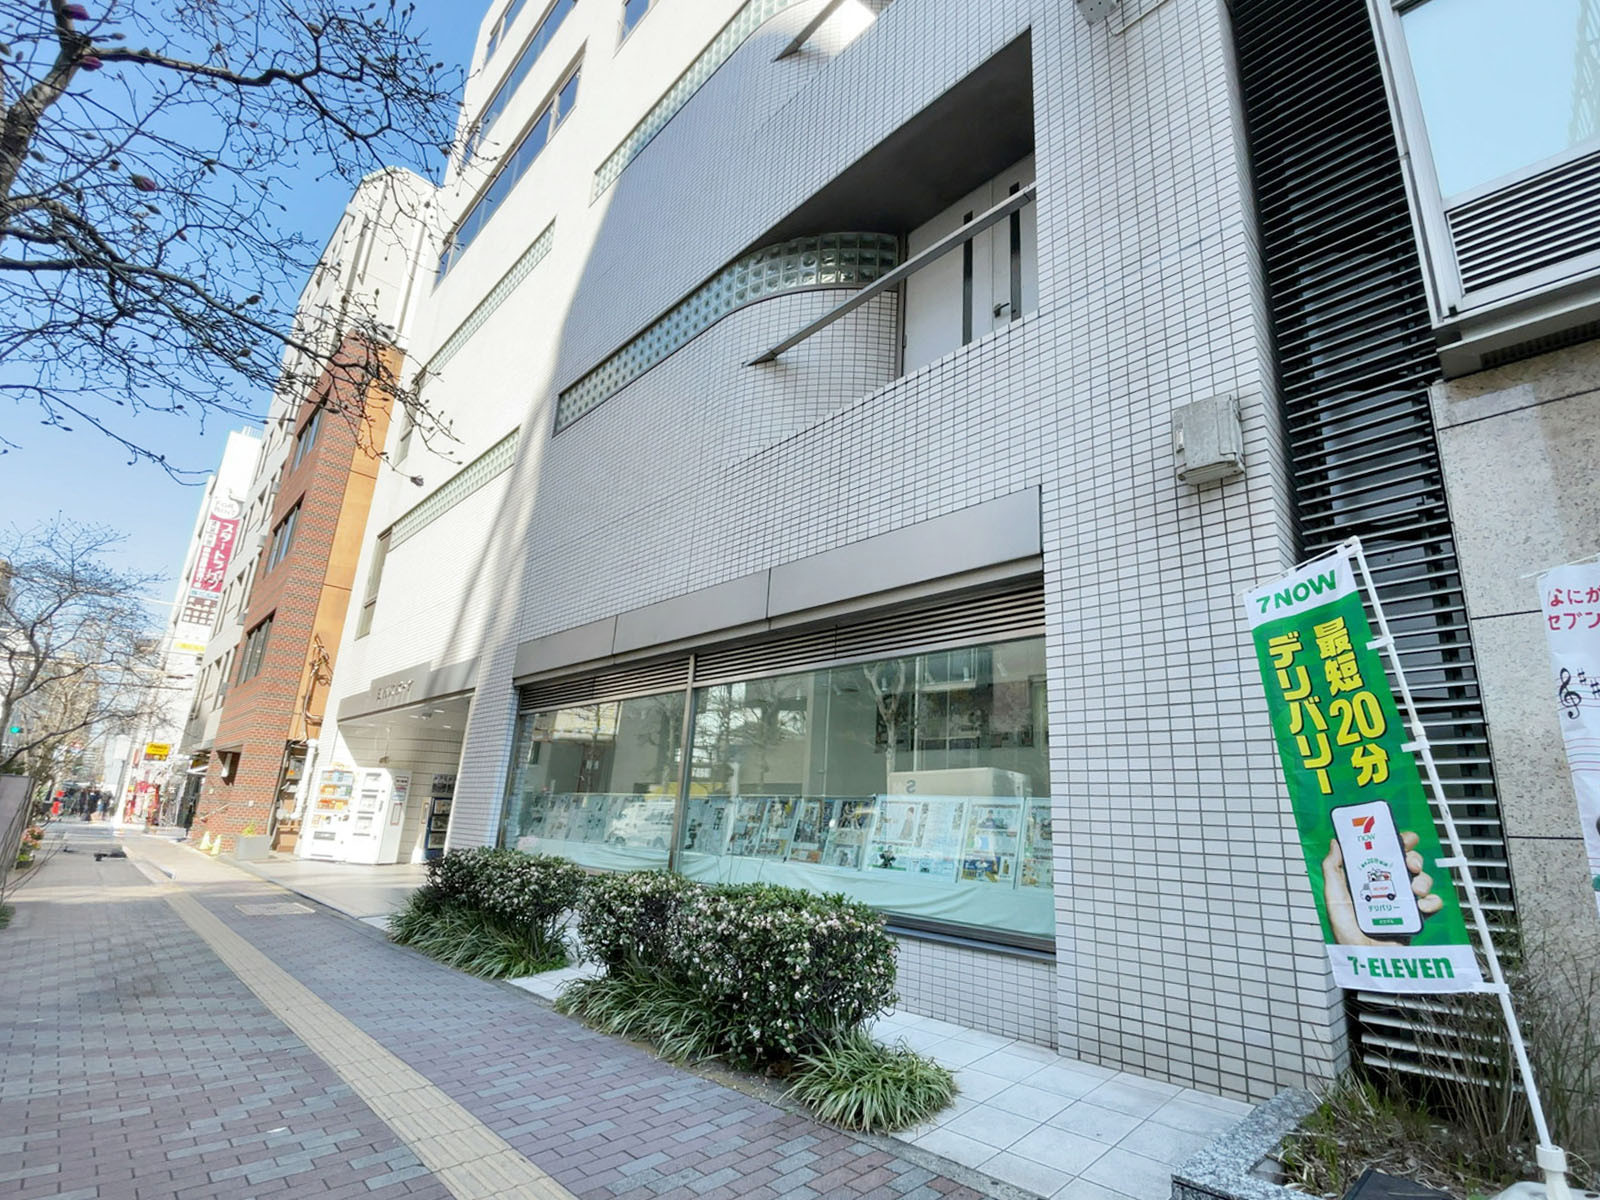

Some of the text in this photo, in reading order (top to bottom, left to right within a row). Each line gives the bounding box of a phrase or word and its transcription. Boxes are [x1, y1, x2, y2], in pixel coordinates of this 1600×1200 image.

[1256, 569, 1337, 614] 7NOW
[1268, 631, 1333, 795] デリバリー
[1313, 616, 1390, 788] 最短20分
